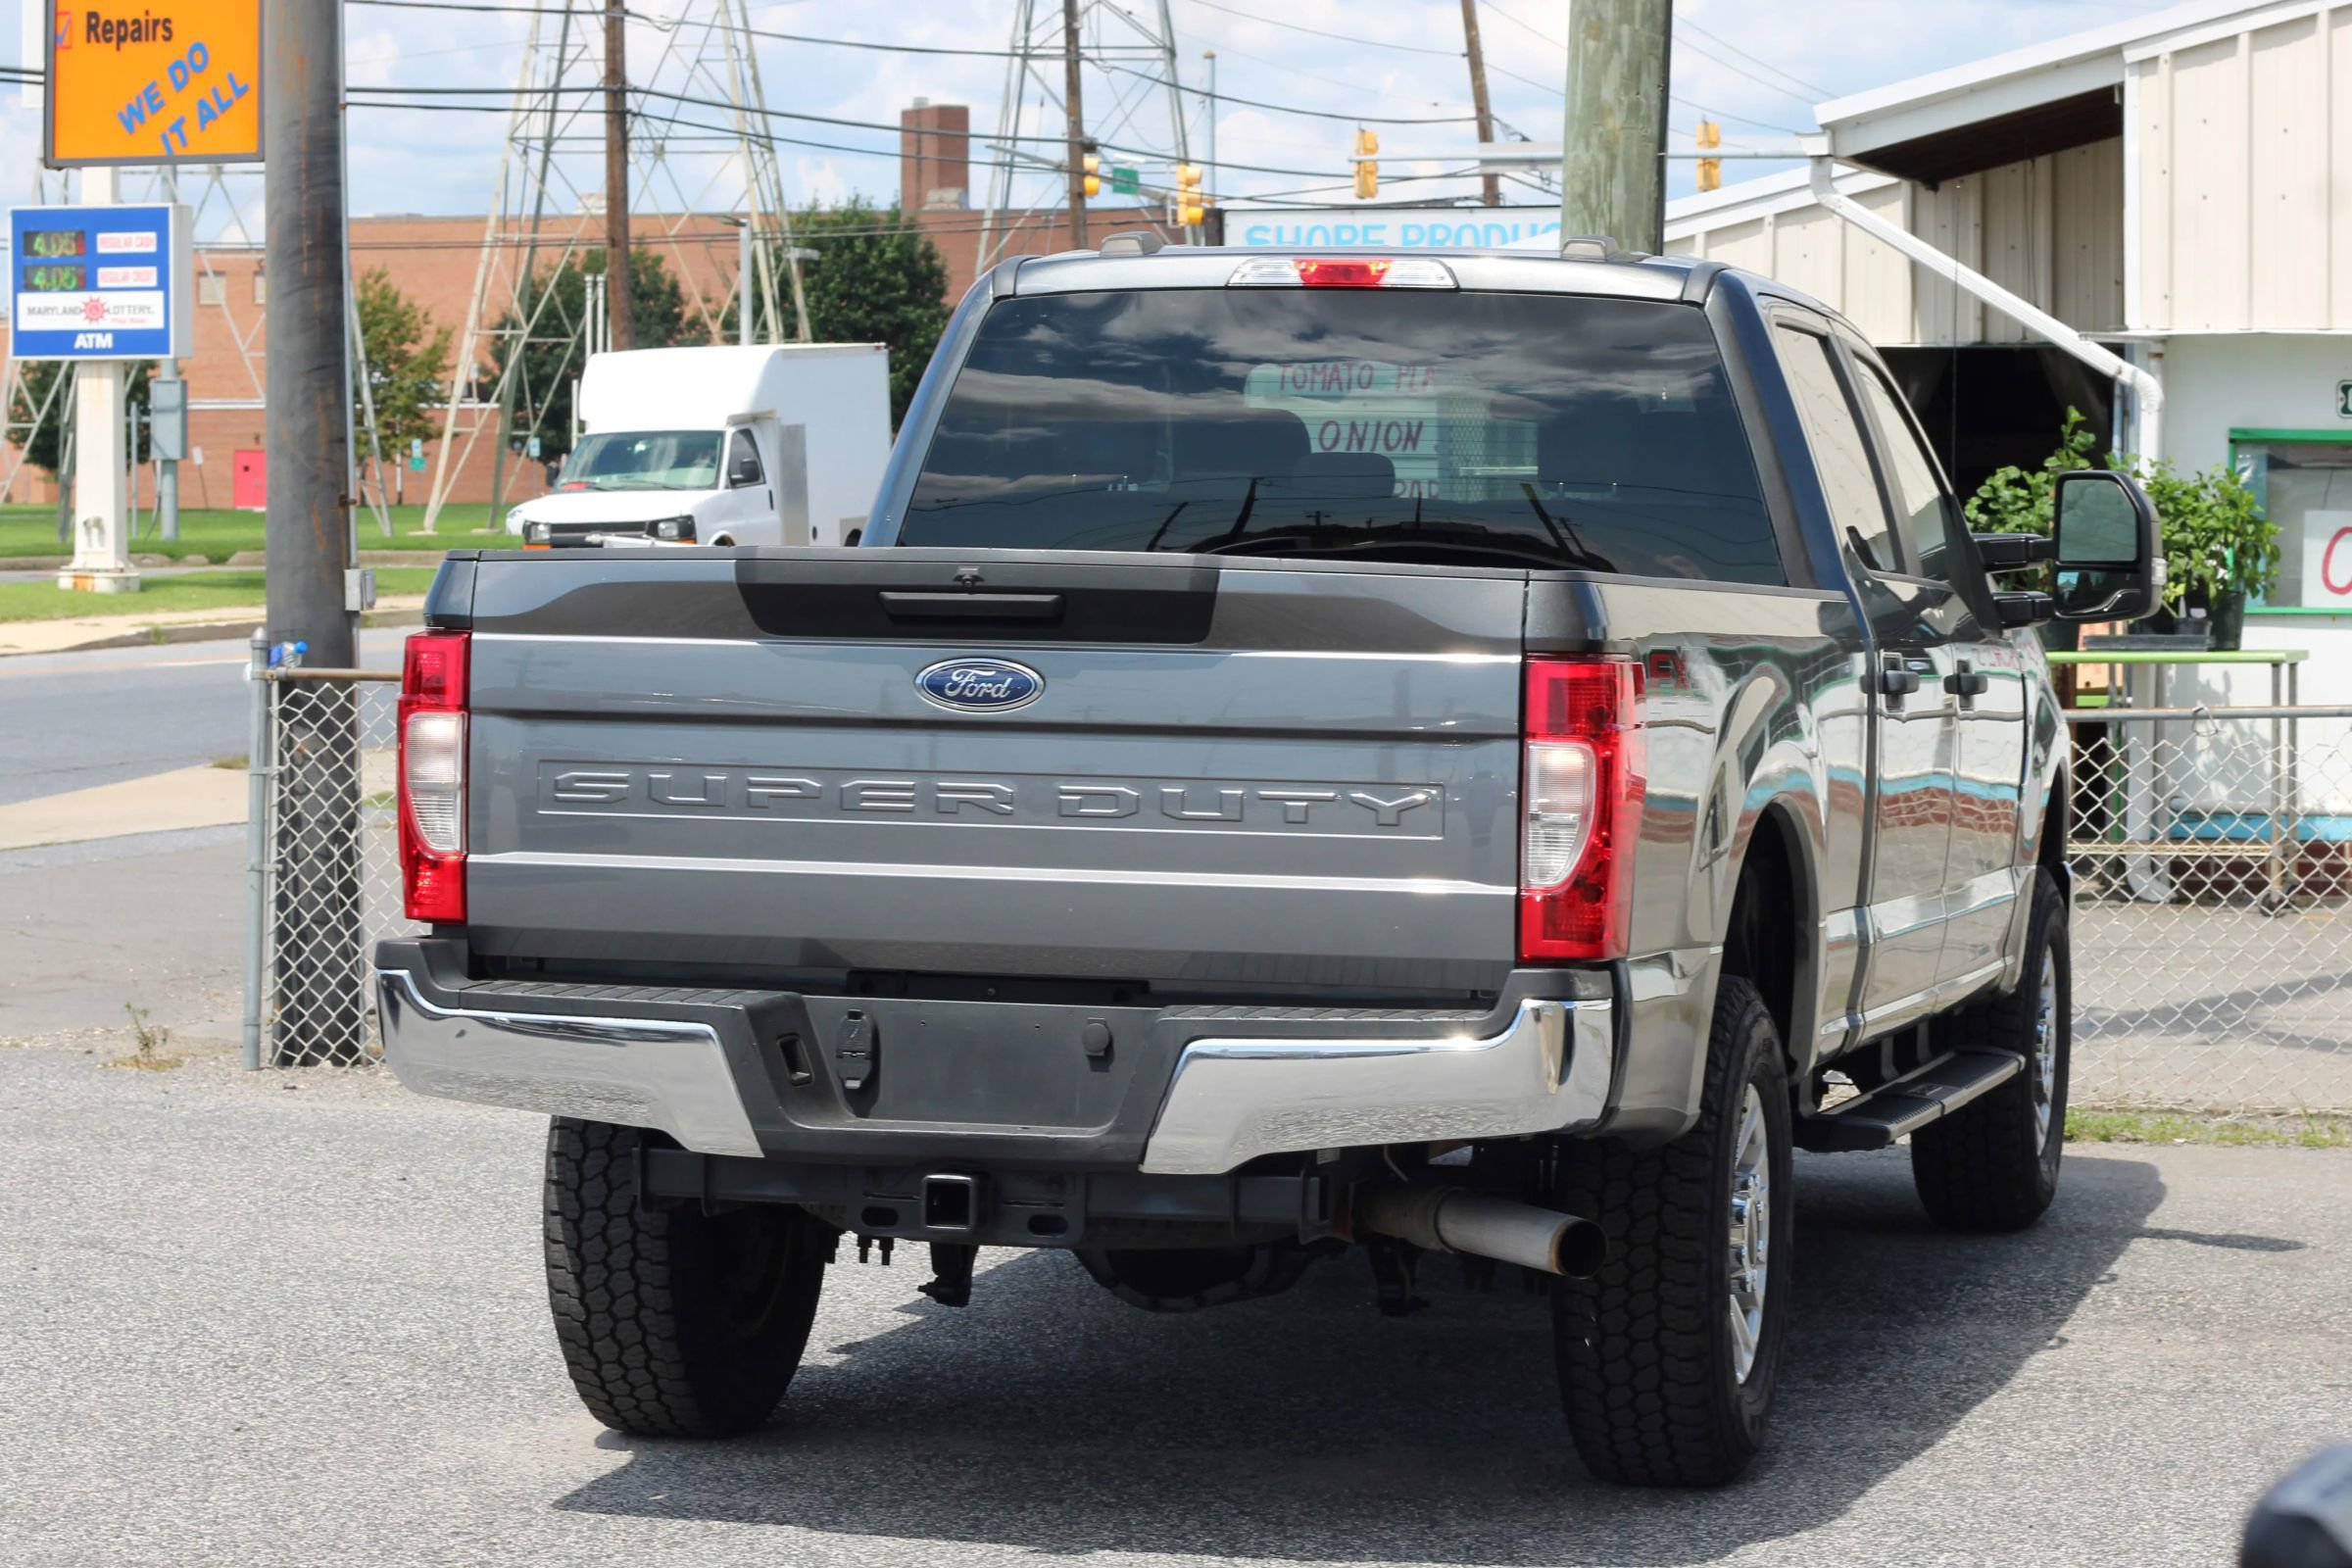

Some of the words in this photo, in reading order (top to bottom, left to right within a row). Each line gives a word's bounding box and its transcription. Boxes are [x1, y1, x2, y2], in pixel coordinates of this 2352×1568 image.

[86, 10, 172, 51] Repairs
[117, 80, 166, 135] WE
[167, 41, 209, 92] DO
[160, 116, 188, 156] IT
[197, 71, 249, 132] ALL
[27, 305, 80, 316] MARYLAND
[74, 332, 114, 349] ATM
[1279, 362, 1375, 392] TOMATO
[1318, 419, 1423, 452] ONION
[945, 668, 1013, 699] Ford
[554, 771, 1015, 816] SUPER
[1057, 785, 1430, 827] DUTY
